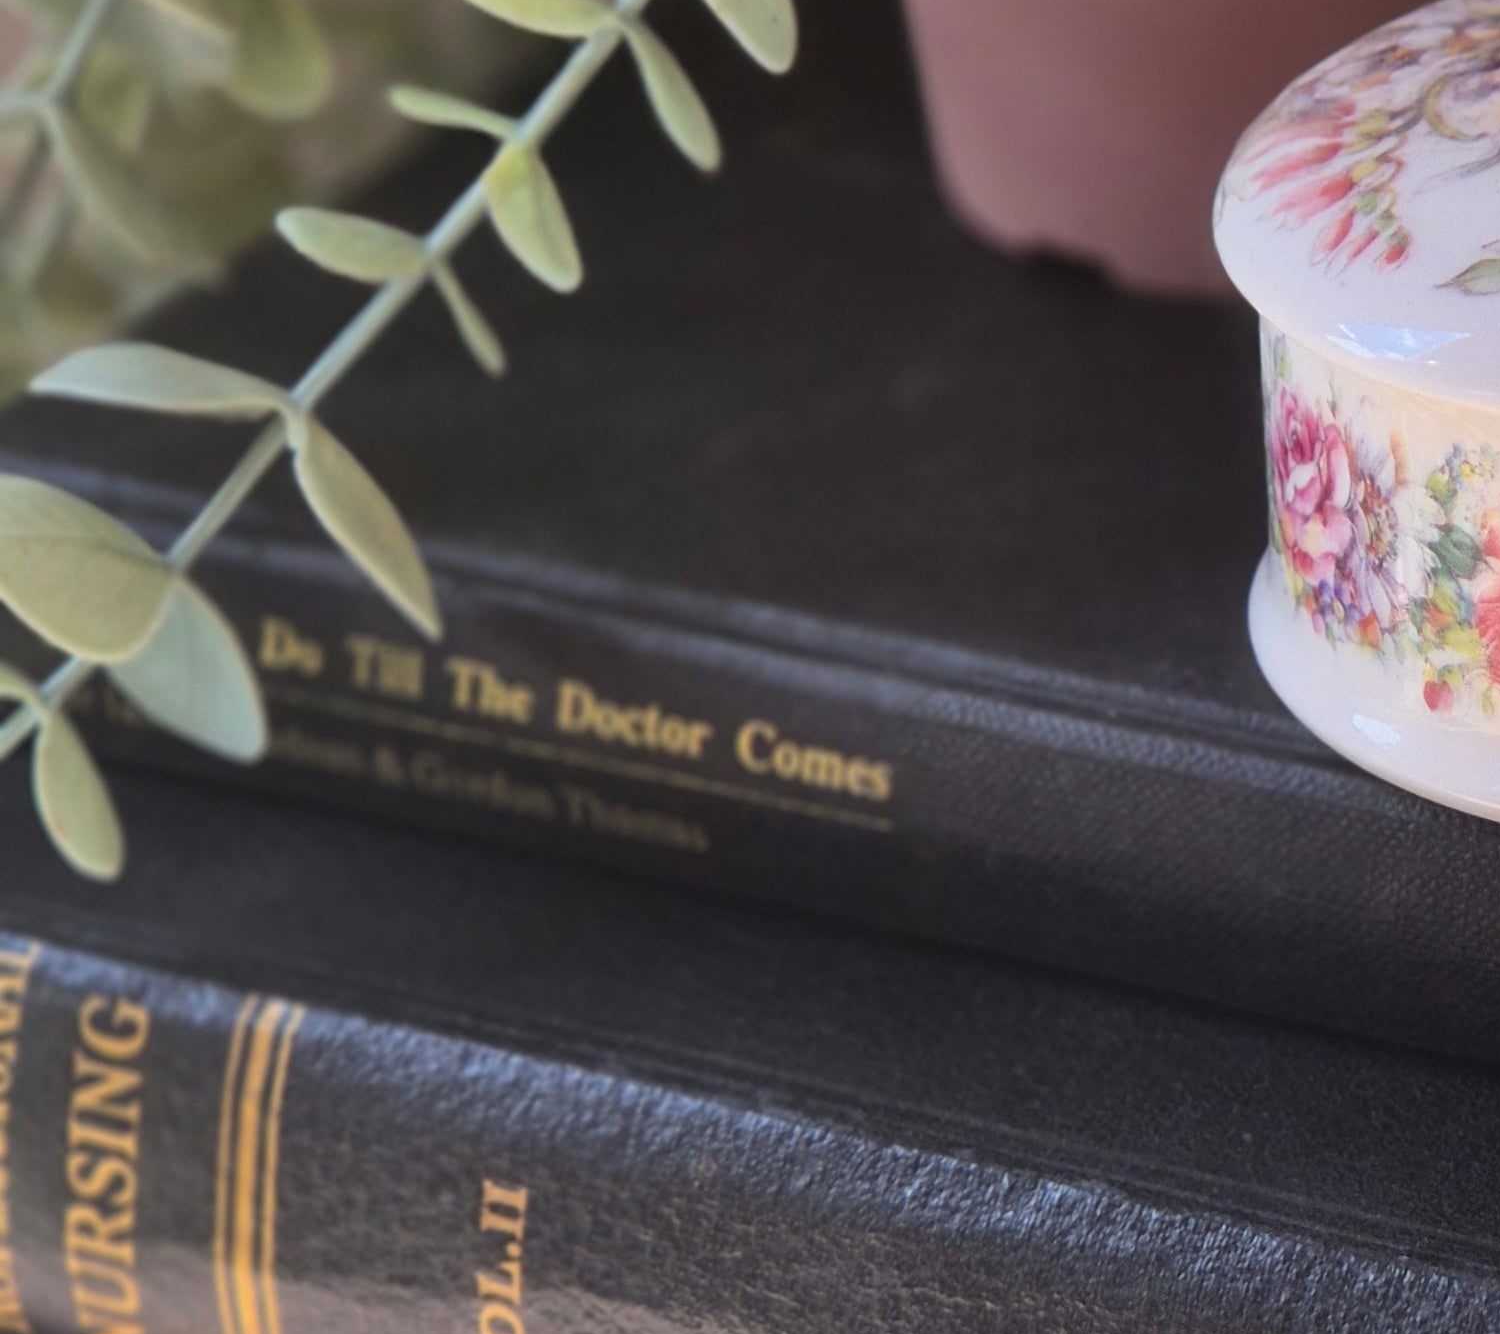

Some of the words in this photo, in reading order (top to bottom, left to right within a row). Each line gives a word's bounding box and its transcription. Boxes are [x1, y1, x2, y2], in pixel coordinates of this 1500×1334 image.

[260, 615, 325, 677] Do
[344, 633, 425, 701] Till
[446, 657, 536, 726] The
[556, 677, 712, 761] Doctor
[736, 719, 892, 804] Comes
